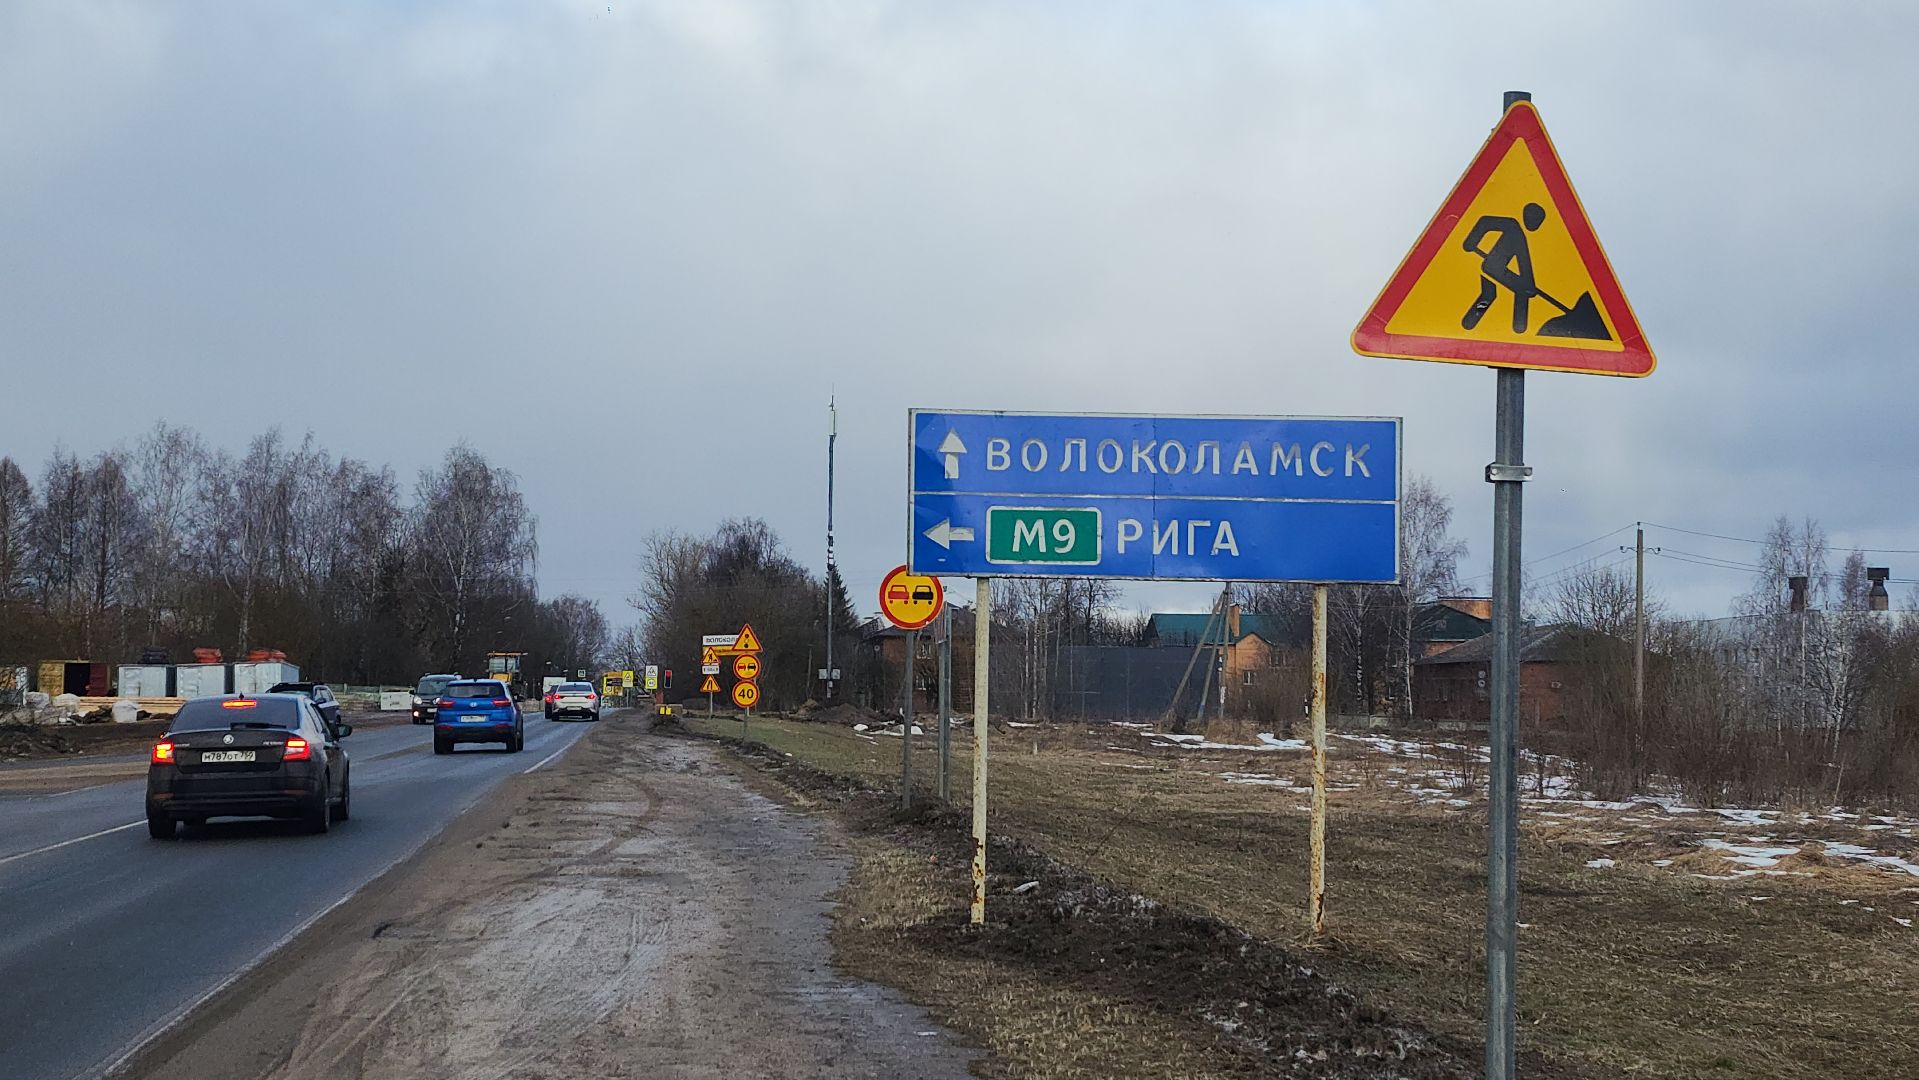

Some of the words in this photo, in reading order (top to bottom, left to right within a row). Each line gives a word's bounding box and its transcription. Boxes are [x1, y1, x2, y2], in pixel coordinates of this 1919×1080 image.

[986, 437, 1372, 478] ВОЛОКОЛАМСК
[1012, 518, 1076, 554] М9
[1117, 518, 1239, 557] РИГА
[738, 688, 754, 699] 40
